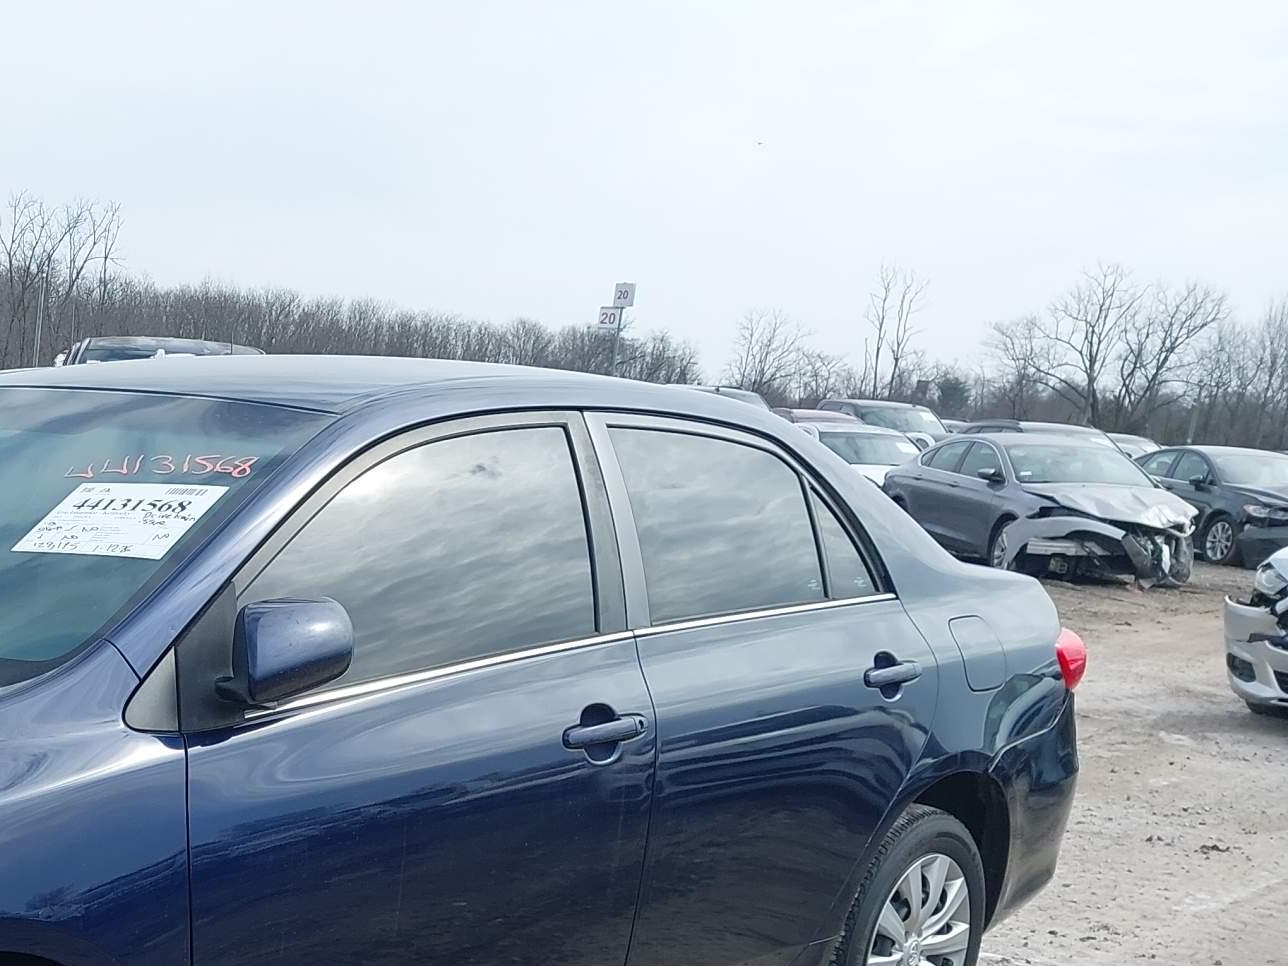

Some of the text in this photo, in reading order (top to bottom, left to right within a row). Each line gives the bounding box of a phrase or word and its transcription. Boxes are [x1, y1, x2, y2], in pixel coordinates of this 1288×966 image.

[617, 290, 629, 300] 20
[600, 312, 616, 325] 20
[63, 454, 260, 478] 44131568
[72, 498, 193, 514] 44131568
